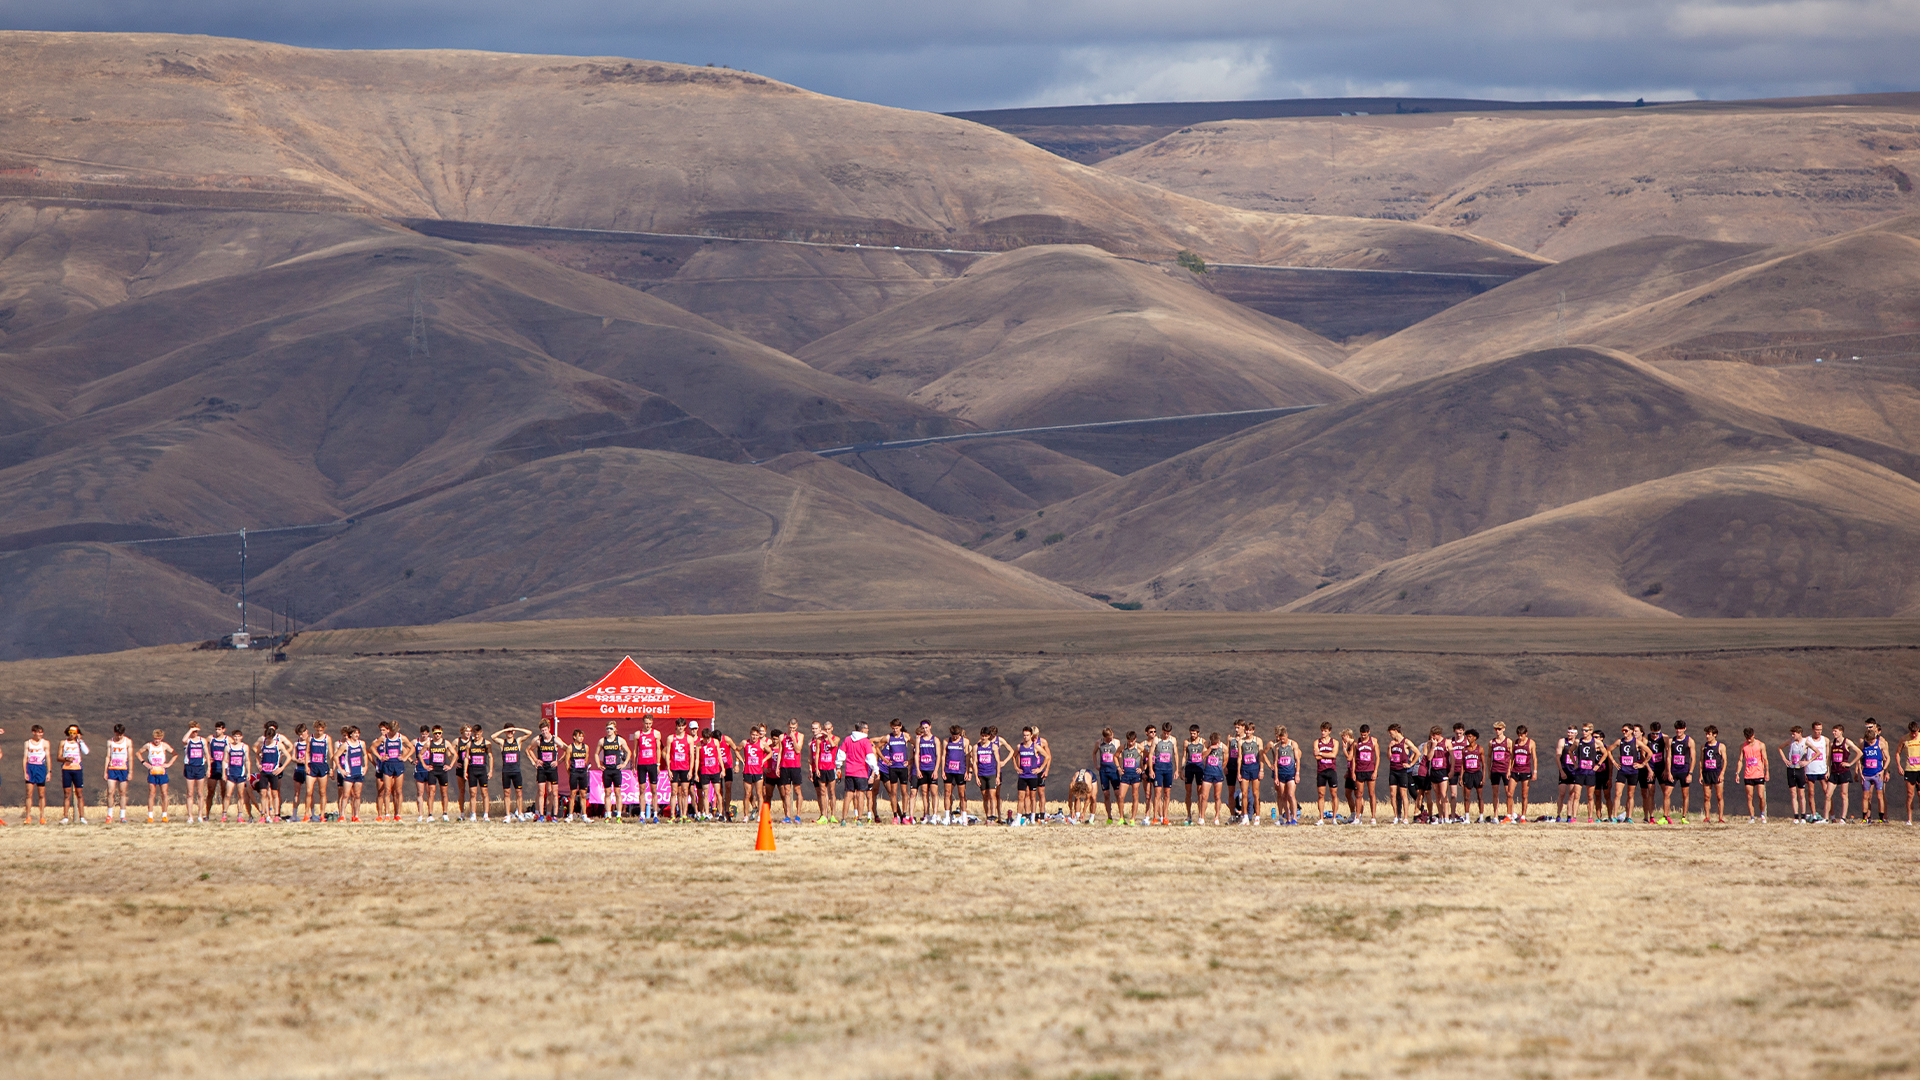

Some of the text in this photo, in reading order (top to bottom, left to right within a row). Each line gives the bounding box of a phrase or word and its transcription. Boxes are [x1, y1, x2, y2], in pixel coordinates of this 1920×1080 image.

[596, 686, 664, 694] LC STATE
[600, 704, 670, 714] Go Warriors!!
